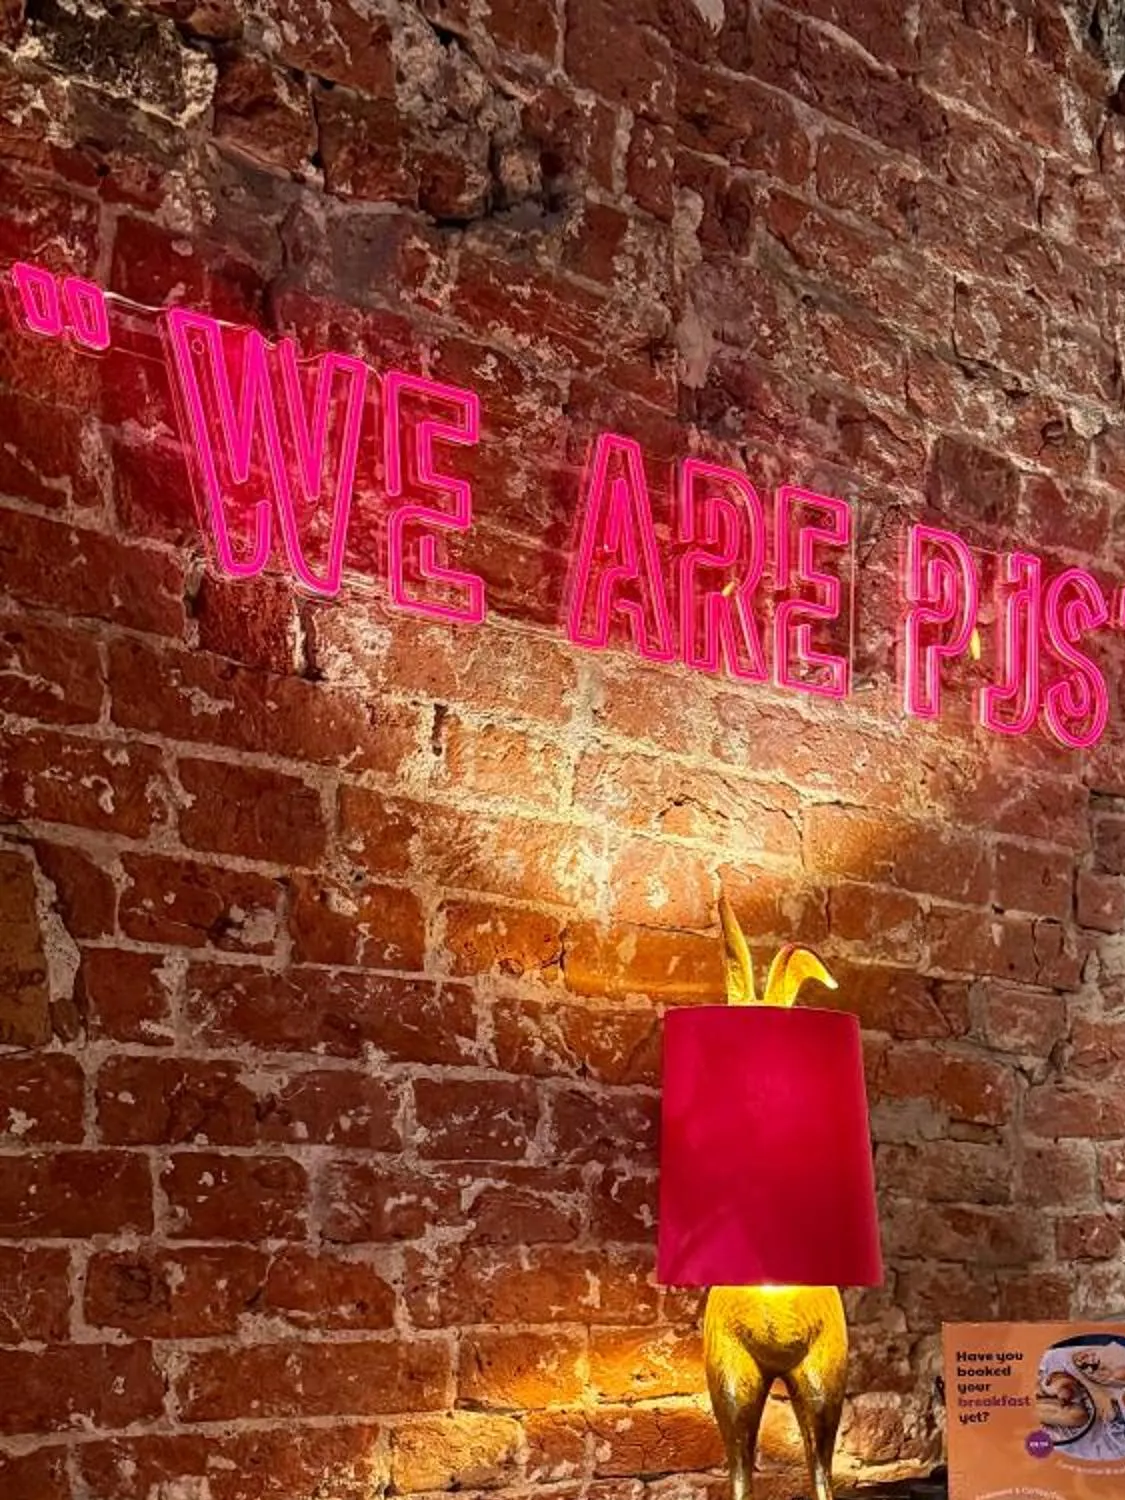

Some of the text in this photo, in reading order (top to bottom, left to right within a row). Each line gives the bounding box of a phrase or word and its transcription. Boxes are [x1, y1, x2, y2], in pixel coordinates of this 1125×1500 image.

[568, 432, 852, 698] ARE
[956, 1351, 1024, 1366] Have you
[957, 1366, 1012, 1377] booked
[957, 1383, 992, 1395] your
[958, 1395, 1032, 1408] breakfast
[959, 1411, 991, 1424] yet?
